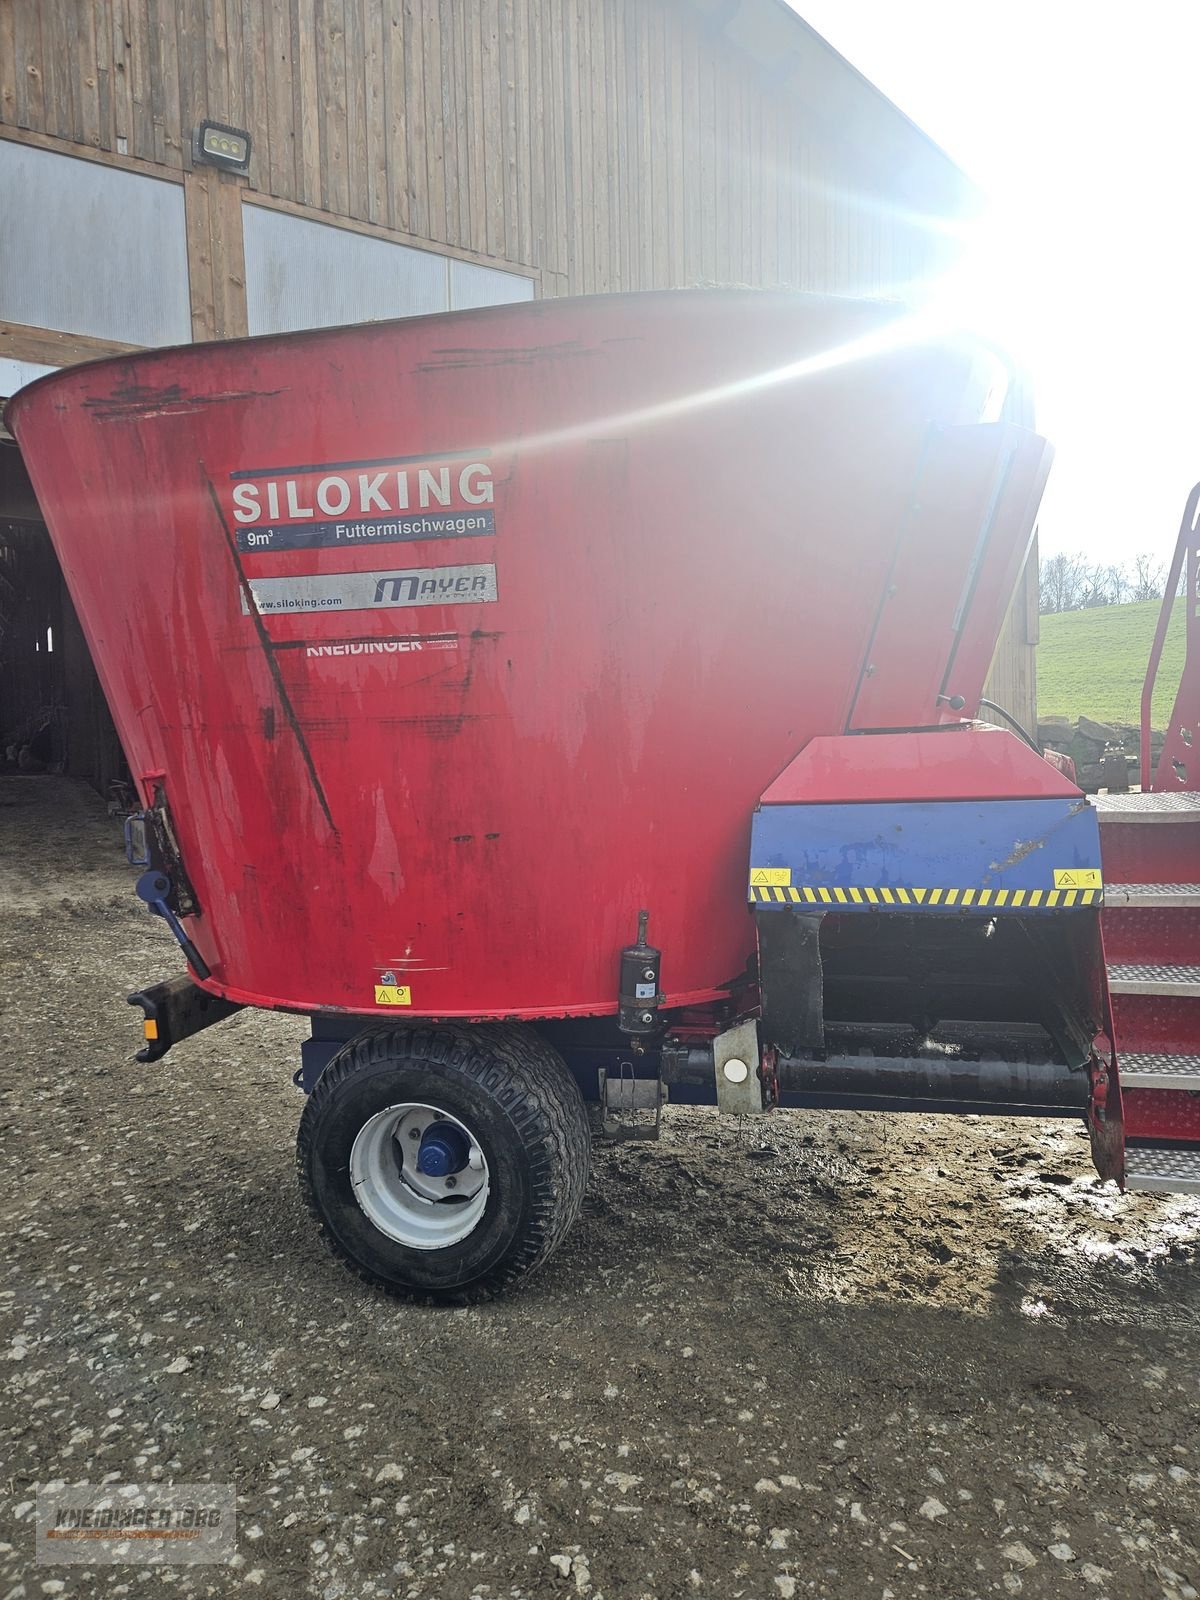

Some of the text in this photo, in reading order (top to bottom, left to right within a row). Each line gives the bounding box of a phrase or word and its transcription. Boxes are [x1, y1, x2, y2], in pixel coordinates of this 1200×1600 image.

[232, 463, 495, 523] SILOKING
[335, 516, 487, 539] Futtermischwagen
[374, 576, 487, 602] MAYER
